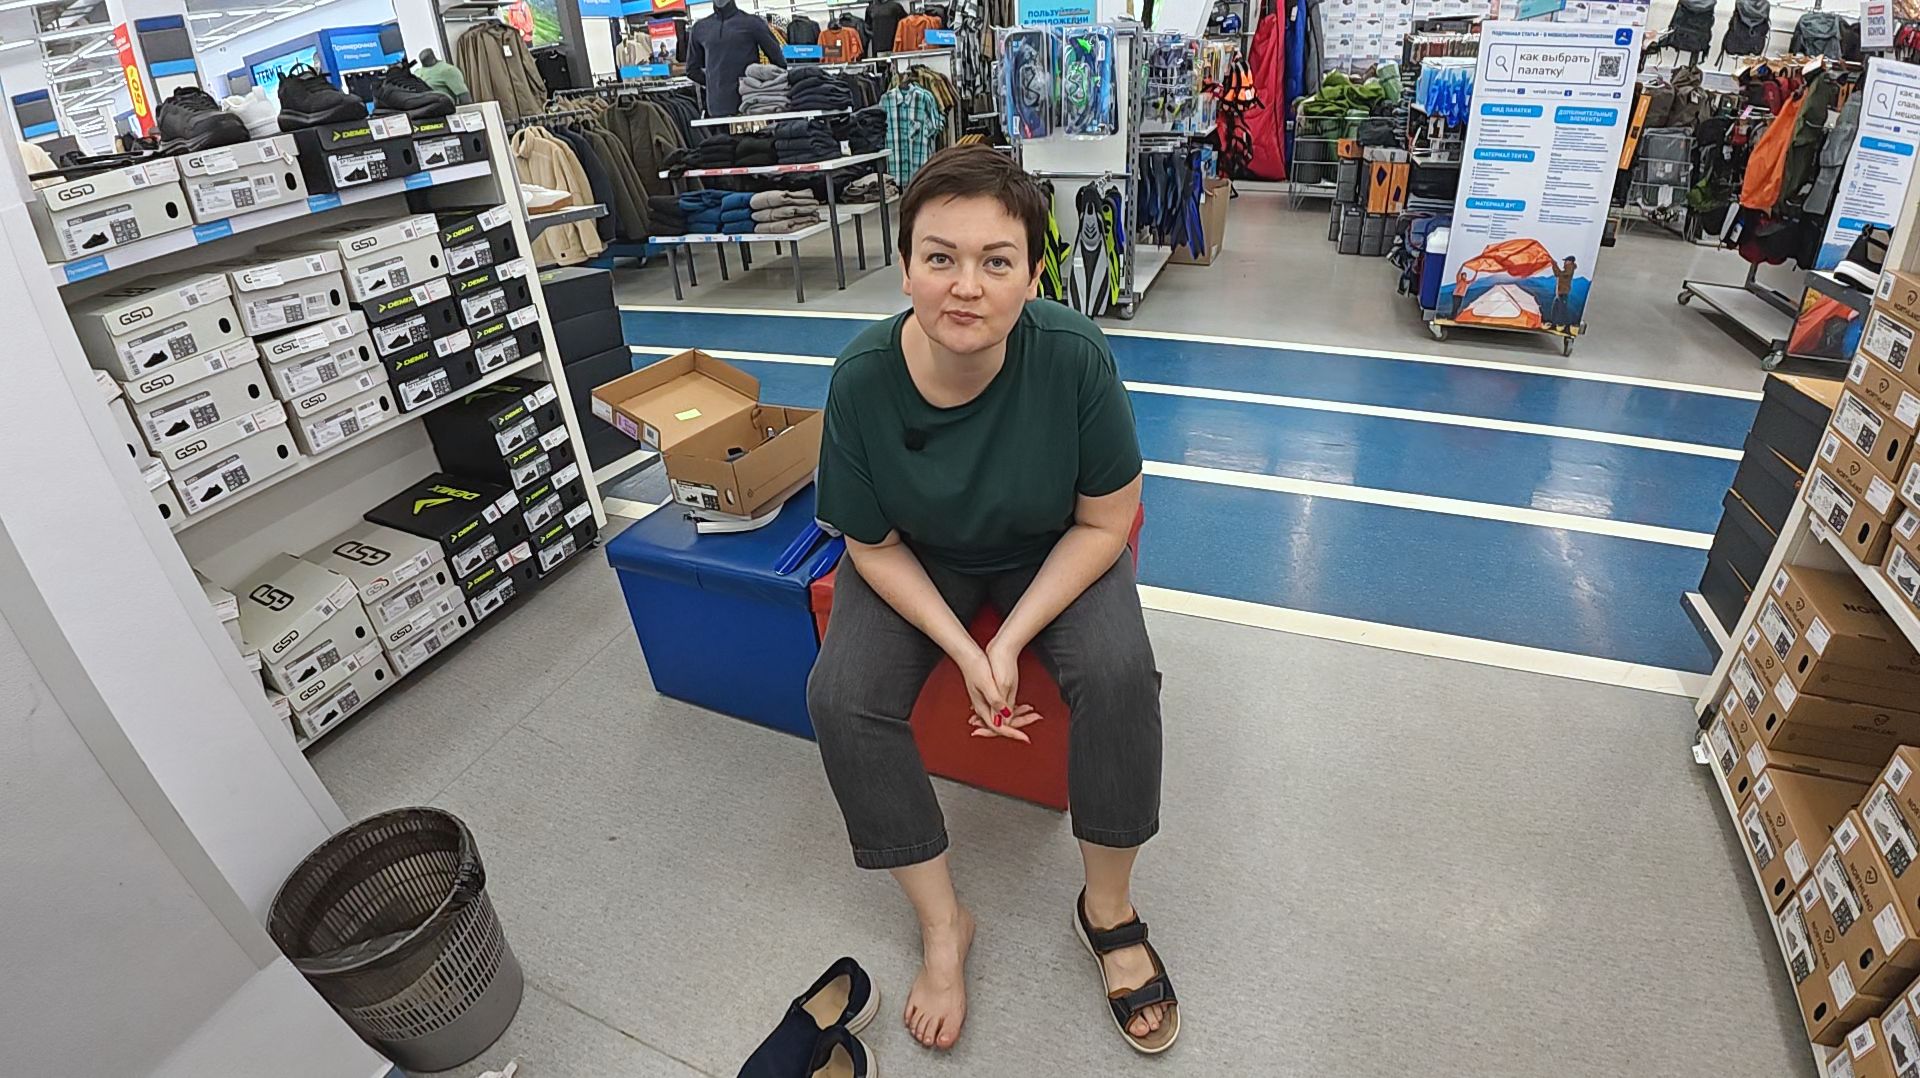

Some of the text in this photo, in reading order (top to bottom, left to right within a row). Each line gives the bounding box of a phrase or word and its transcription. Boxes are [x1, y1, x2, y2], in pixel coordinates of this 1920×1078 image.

[1520, 53, 1590, 64] как выбрать
[1518, 66, 1562, 78] палатку
[1557, 110, 1613, 118] ДОПОЛНИТЕЛЬНЫЕ
[420, 123, 444, 132] DEMIX
[58, 183, 95, 201] GSD
[452, 224, 474, 238] DEMIX
[351, 236, 377, 251] GSD
[467, 275, 489, 288] DEMIX
[387, 295, 414, 309] DEMIX
[119, 306, 154, 326] GSD
[483, 322, 504, 336] DEMIX
[404, 351, 429, 367] DEMIX
[140, 374, 175, 393] GSD
[300, 392, 327, 410] GSD
[505, 406, 524, 421] DEMIX
[175, 439, 208, 460] GSD
[519, 445, 538, 460] DEMIX
[1836, 467, 1862, 495] NORTHLAND
[427, 485, 480, 500] DEMIX
[530, 484, 549, 500] DEMIX
[457, 520, 479, 537] DEMIX
[546, 524, 564, 539] DEMIX
[332, 542, 391, 566] GSD
[474, 568, 496, 584] DEMIX
[249, 584, 294, 611] GSD
[1784, 600, 1805, 630] NORTHLAND
[390, 624, 412, 642] GSD
[272, 630, 299, 654] GSD
[1754, 657, 1773, 687] NORTHLAND
[299, 680, 326, 701] GSD
[1765, 810, 1783, 849] NORTHLAND
[1849, 862, 1873, 912] NORTHLAND
[1812, 920, 1831, 970] NORTHLAND
